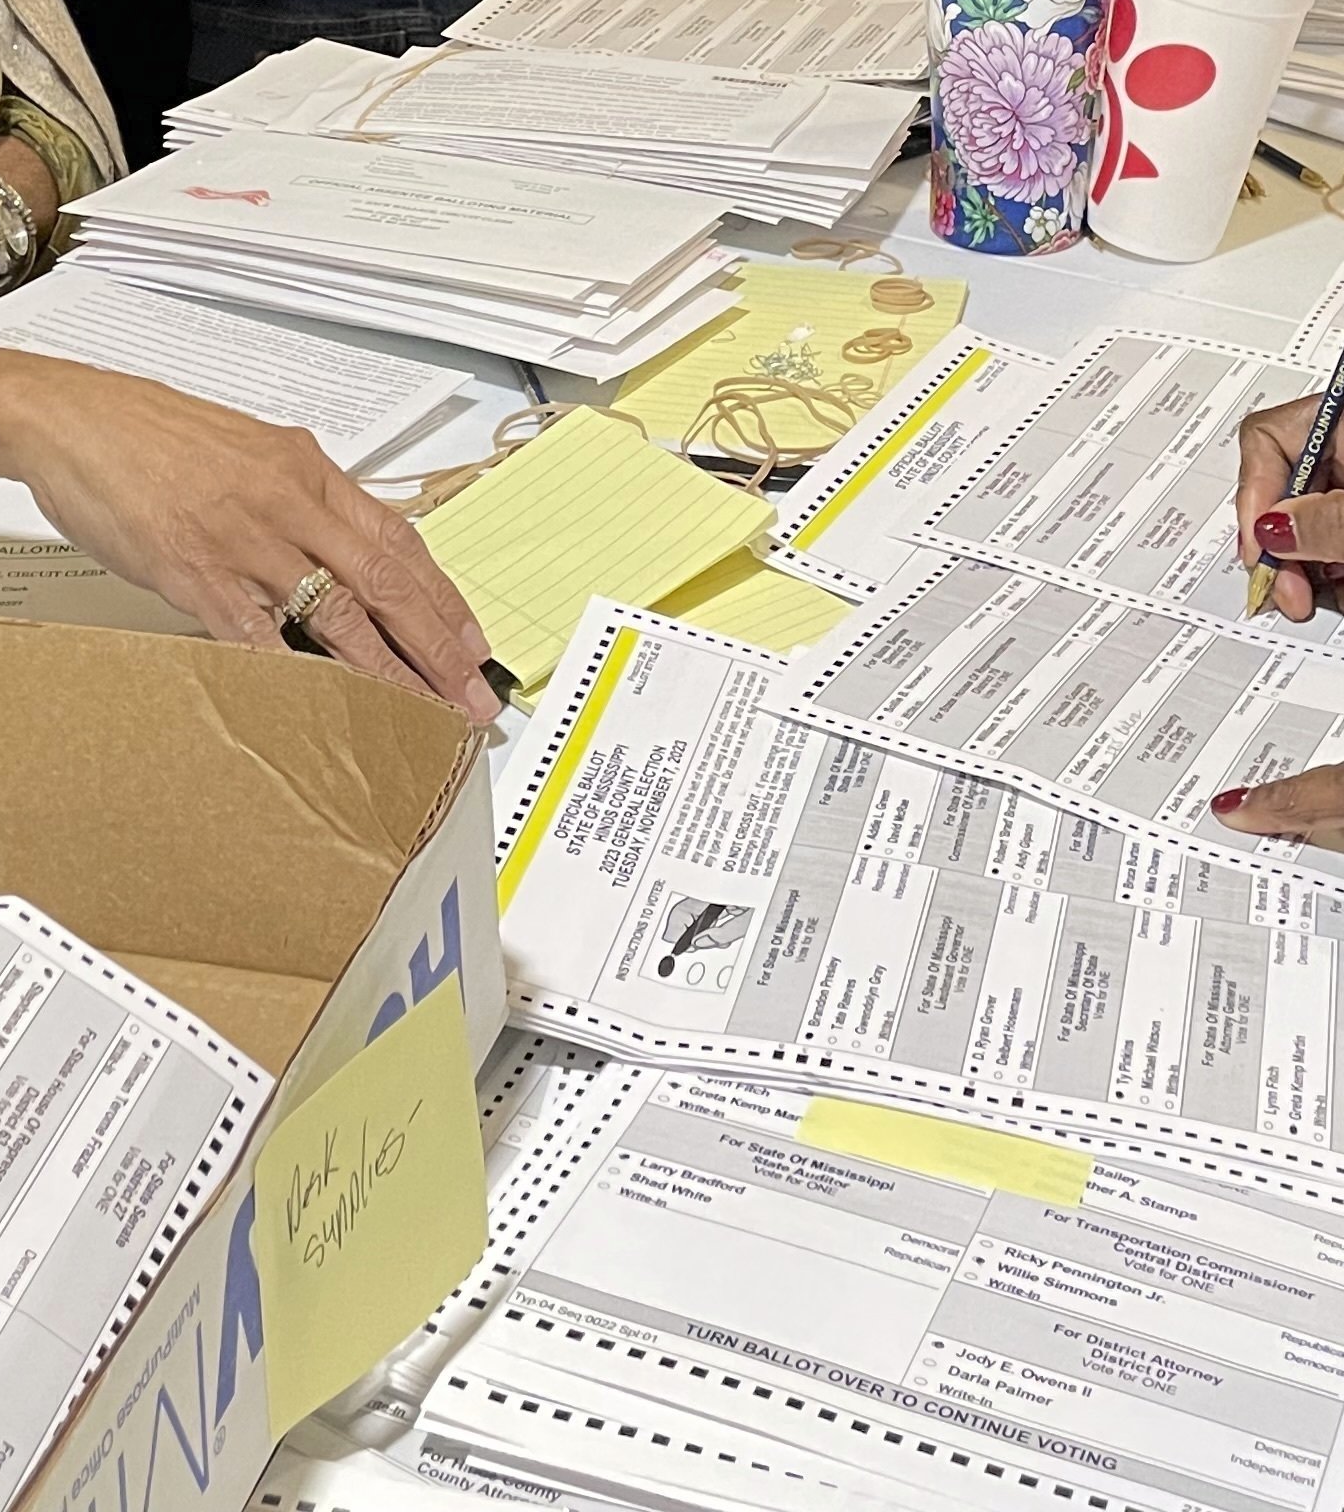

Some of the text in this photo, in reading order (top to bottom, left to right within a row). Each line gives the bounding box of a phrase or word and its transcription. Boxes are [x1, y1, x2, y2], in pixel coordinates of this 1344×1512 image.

[1291, 454, 1316, 497] HINDS
[1309, 398, 1336, 454] COUNTY
[554, 749, 606, 839] OFFICIAL BALLOT
[566, 743, 628, 855] STATE OF MISSISSIPPI
[592, 764, 637, 842] HINDS COUNTY
[598, 744, 666, 874] 2023 GENERAL ELECTION
[611, 739, 687, 887] TUESDAY, NOVEMBER 7, 2023
[721, 792, 759, 872] DO NOT CROSS OUT
[689, 1086, 803, 1121] Greta Kemp Mar
[639, 1158, 746, 1194] Larry Bradford
[719, 1134, 895, 1191] For State Of Mississippi
[751, 1155, 856, 1188] State Auditor
[1092, 1165, 1140, 1187] Bailey
[629, 1172, 712, 1203] Shad White
[883, 1247, 951, 1274] Republican
[900, 1233, 960, 1256] Democrat
[1043, 1208, 1314, 1299] For Transportation Commissioner
[1113, 1241, 1233, 1288] Central District
[997, 1261, 1117, 1306] Willie Simmons
[1004, 1246, 1165, 1303] Ricky Pennington Jr.
[955, 1348, 1092, 1397] Jody E. Owens II
[1052, 1323, 1223, 1386] For District Attorney
[1090, 1347, 1177, 1381] District 07
[686, 1322, 1117, 1470] TURN BALLOT OVER TO CONTINUE VOTING
[947, 1365, 1053, 1405] Darla Palmer
[71, 1426, 116, 1502] Office
[1230, 1454, 1316, 1487] Independent
[1254, 1441, 1323, 1468] Democrat
